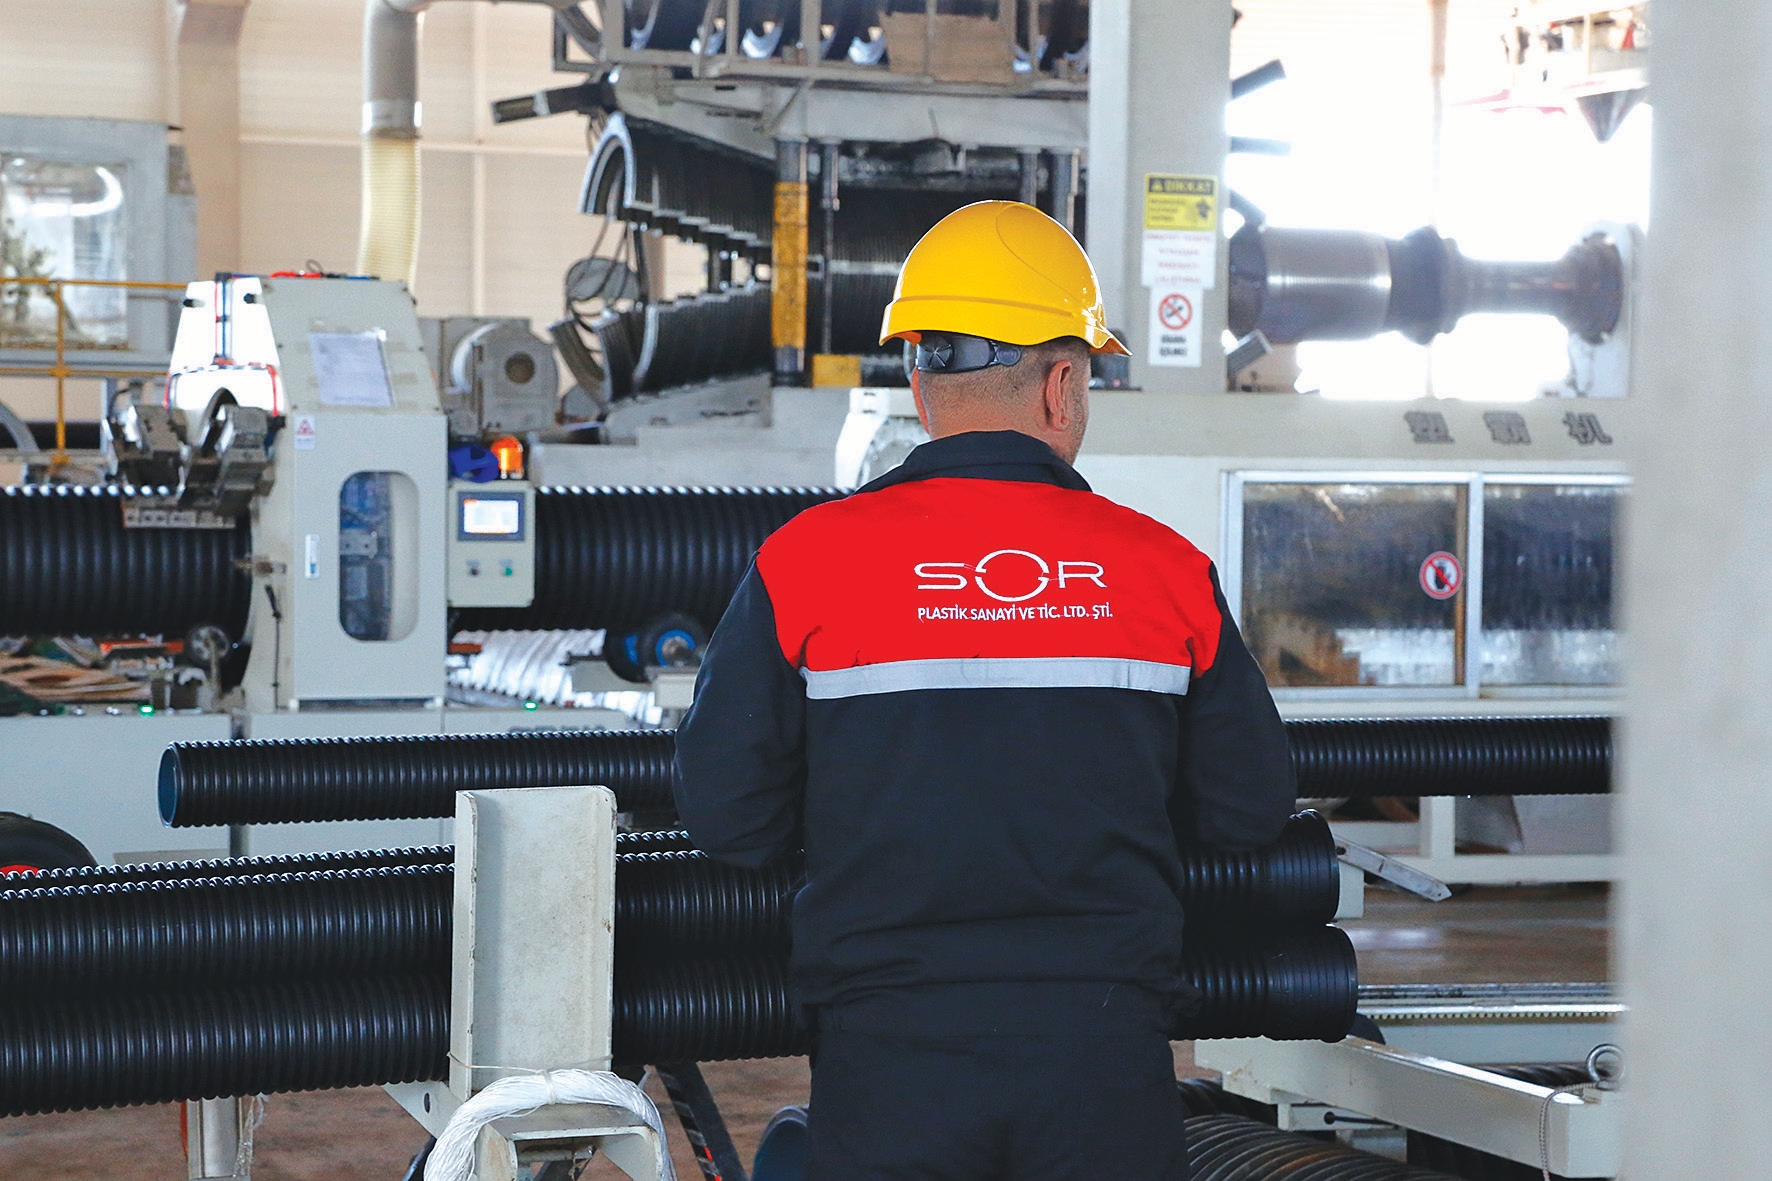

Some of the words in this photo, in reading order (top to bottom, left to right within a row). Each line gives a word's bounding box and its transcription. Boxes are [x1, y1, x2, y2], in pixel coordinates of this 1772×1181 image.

[913, 549, 1107, 602] SOR
[917, 604, 969, 621] PLASTİK
[970, 604, 1016, 621] SANAYİ
[1018, 606, 1035, 621] VE
[1063, 605, 1089, 619] LTD.
